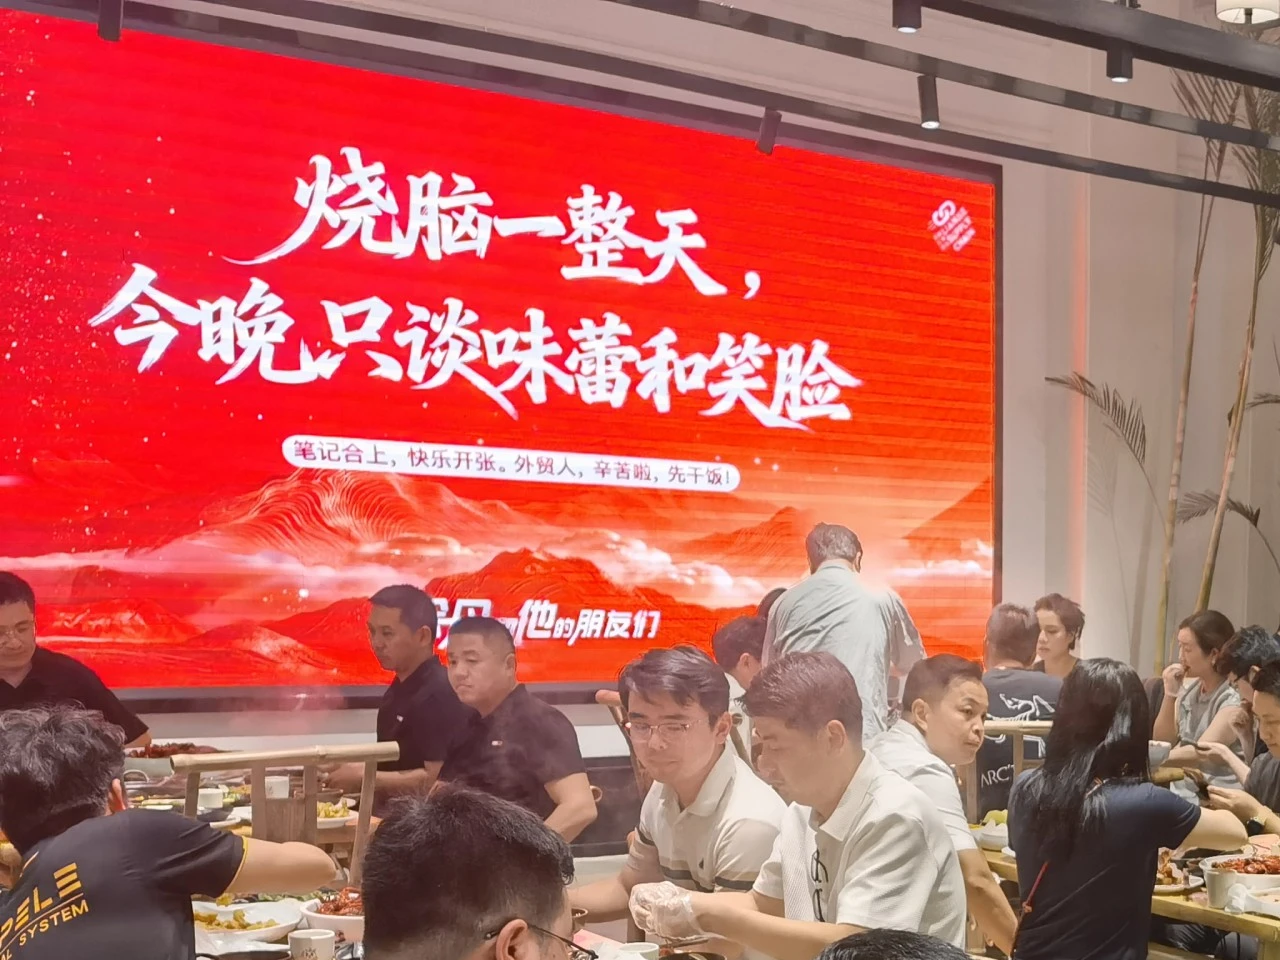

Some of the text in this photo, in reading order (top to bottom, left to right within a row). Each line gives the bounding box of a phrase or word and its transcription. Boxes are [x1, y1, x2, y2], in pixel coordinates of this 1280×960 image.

[220, 146, 761, 299] 烧脑一整天，
[87, 262, 863, 431] 今晚只谈味蕾和笑脸
[19, 899, 89, 946] SYSTEM
